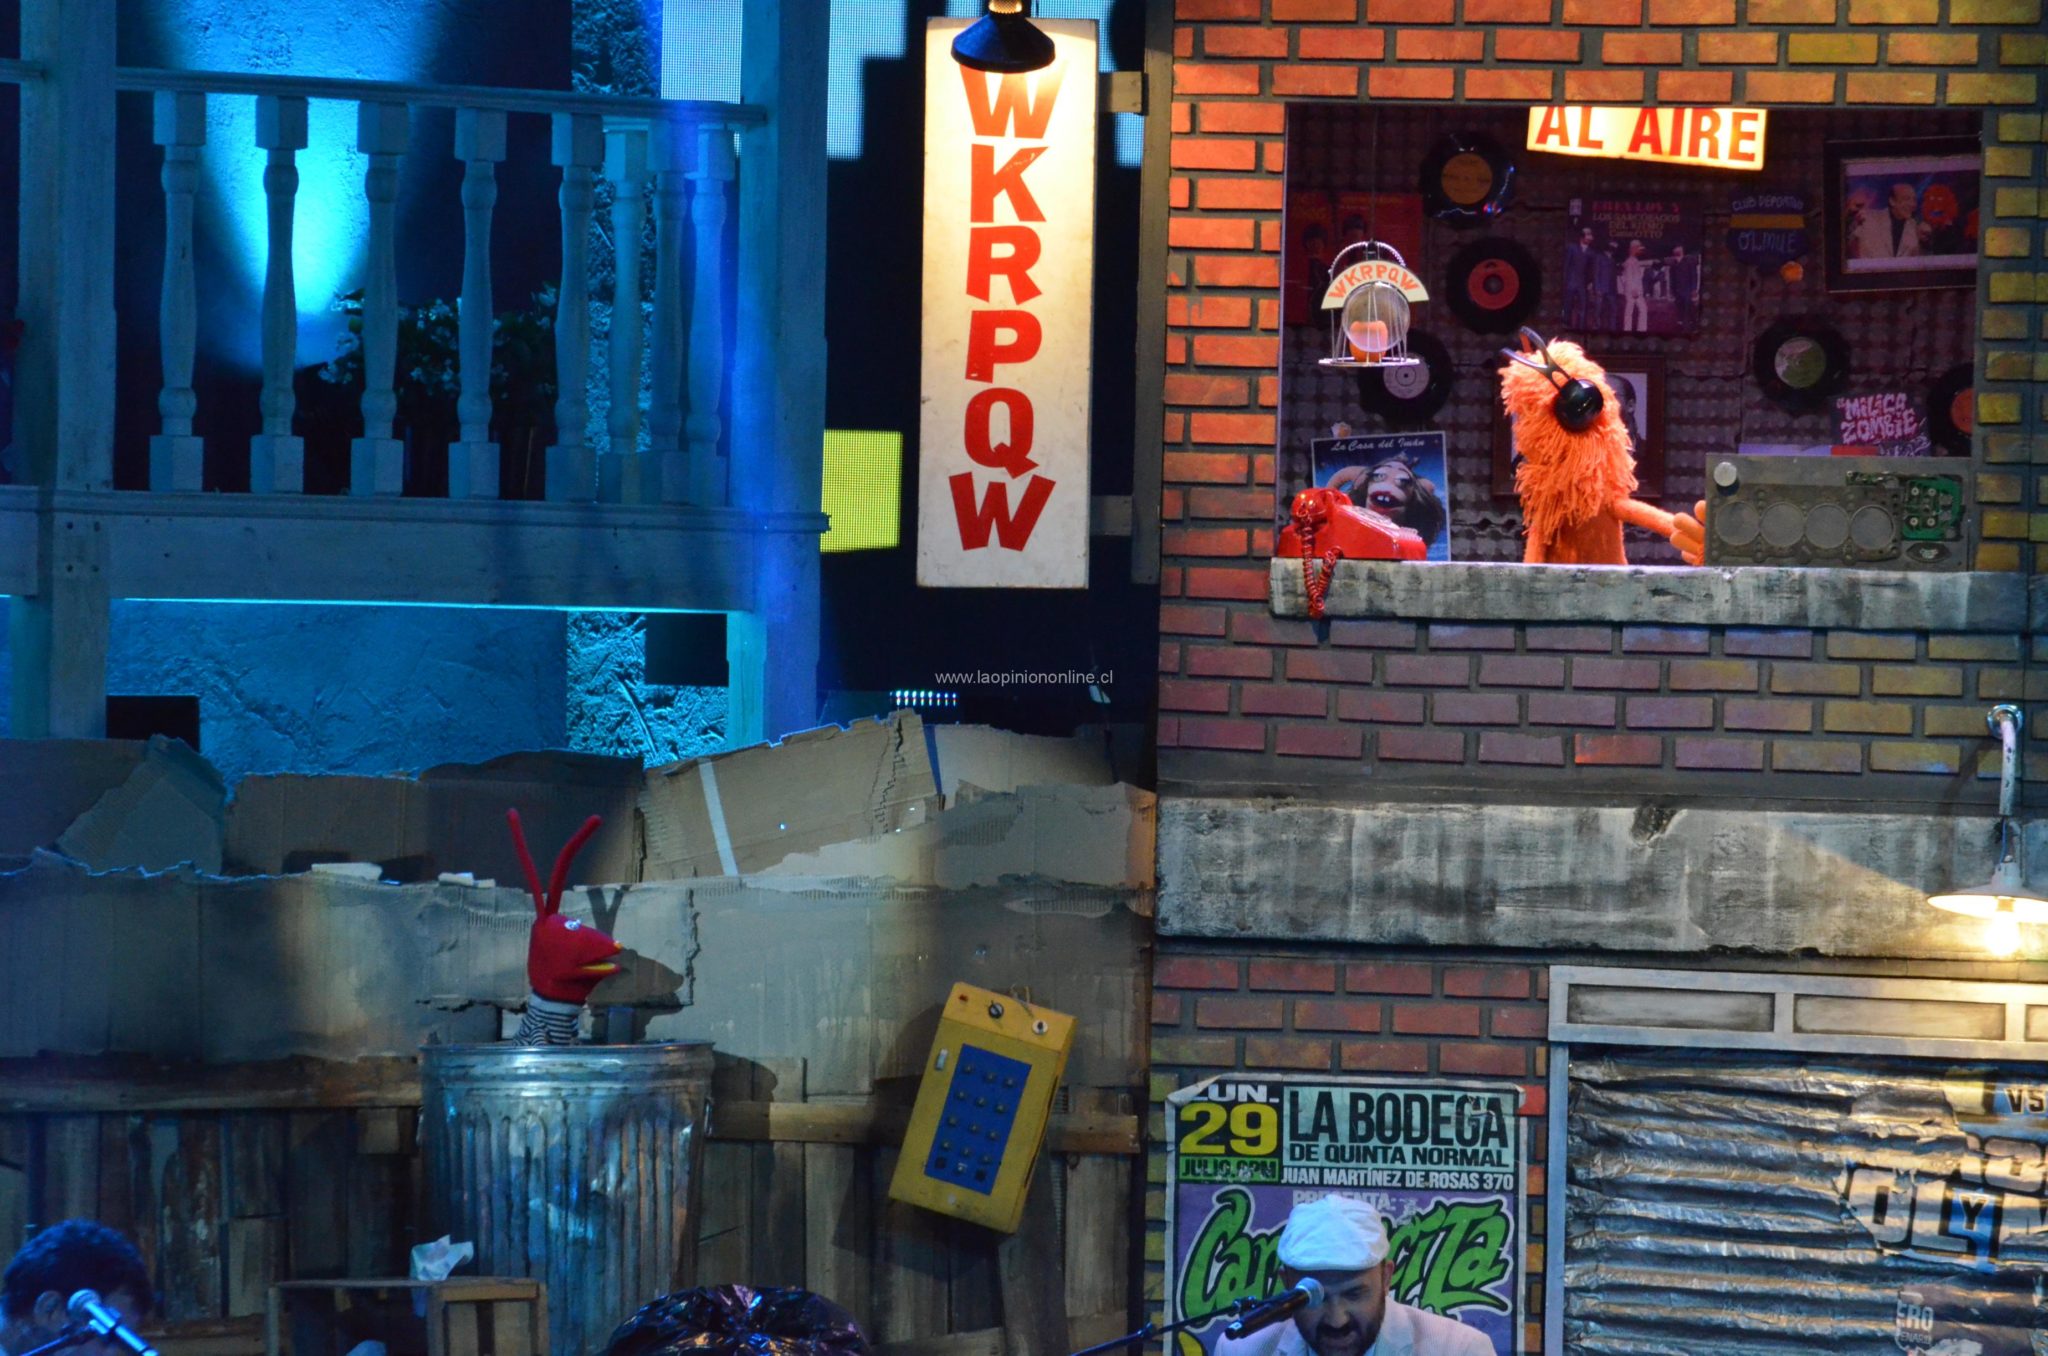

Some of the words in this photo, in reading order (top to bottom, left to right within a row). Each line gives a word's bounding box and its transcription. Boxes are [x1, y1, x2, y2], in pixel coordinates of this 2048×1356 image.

[1535, 106, 1604, 150] AL
[1627, 106, 1760, 162] AIRE
[1327, 264, 1420, 299] WKRPQW
[948, 62, 1068, 552] WKRPQW
[1330, 440, 1346, 452] La
[1348, 440, 1375, 452] Casa
[1378, 438, 1394, 449] del
[1179, 1102, 1279, 1156] 29
[1289, 1090, 1339, 1143] LA
[1348, 1091, 1509, 1149] BODEGA
[1289, 1143, 1320, 1163] DE
[1324, 1144, 1407, 1165] QUINTA
[1411, 1146, 1510, 1168] NORMAL
[1281, 1166, 1320, 1185] JUAN
[1405, 1170, 1426, 1188] DE
[1428, 1171, 1480, 1190] ROSAS
[1483, 1173, 1515, 1192] 370
